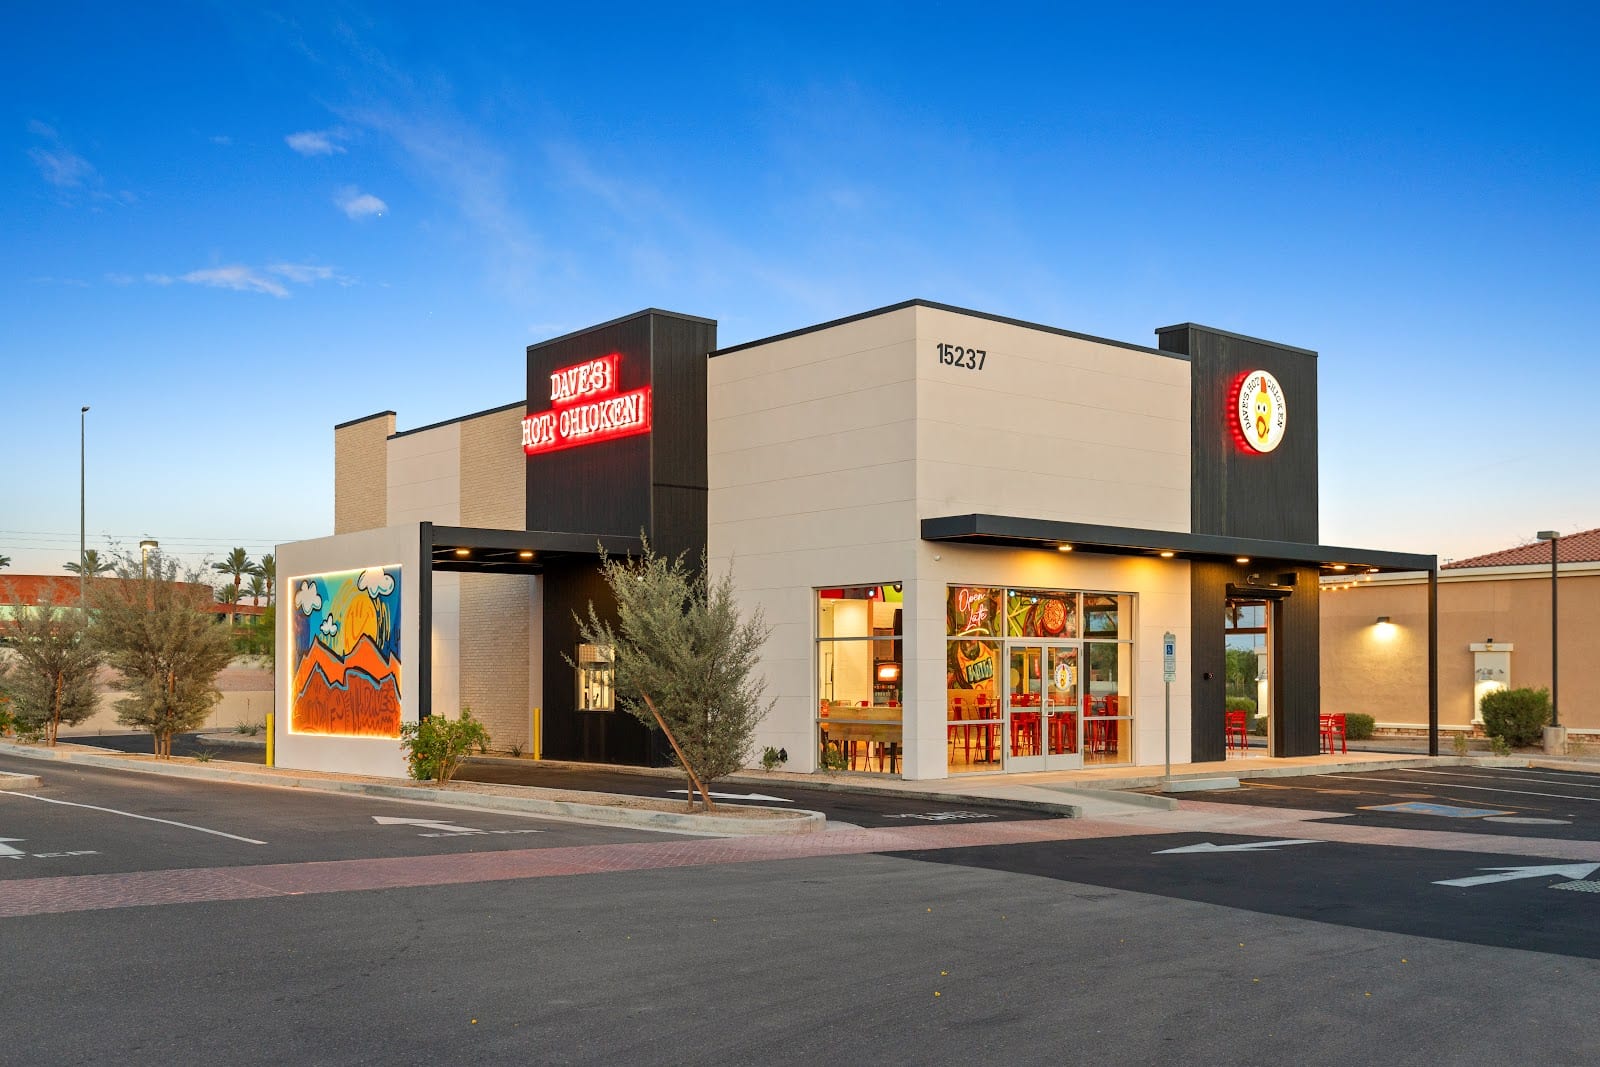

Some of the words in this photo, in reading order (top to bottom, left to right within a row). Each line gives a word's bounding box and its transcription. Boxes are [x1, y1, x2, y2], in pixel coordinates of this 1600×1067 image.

[937, 343, 986, 370] 15237
[550, 361, 605, 400] DAVE'S
[1247, 376, 1260, 393] HOT
[1267, 379, 1283, 428] CHICKEN
[521, 414, 552, 445] HOT
[560, 394, 640, 437] CHICKEN
[959, 588, 986, 612] Open
[966, 603, 989, 631] Late
